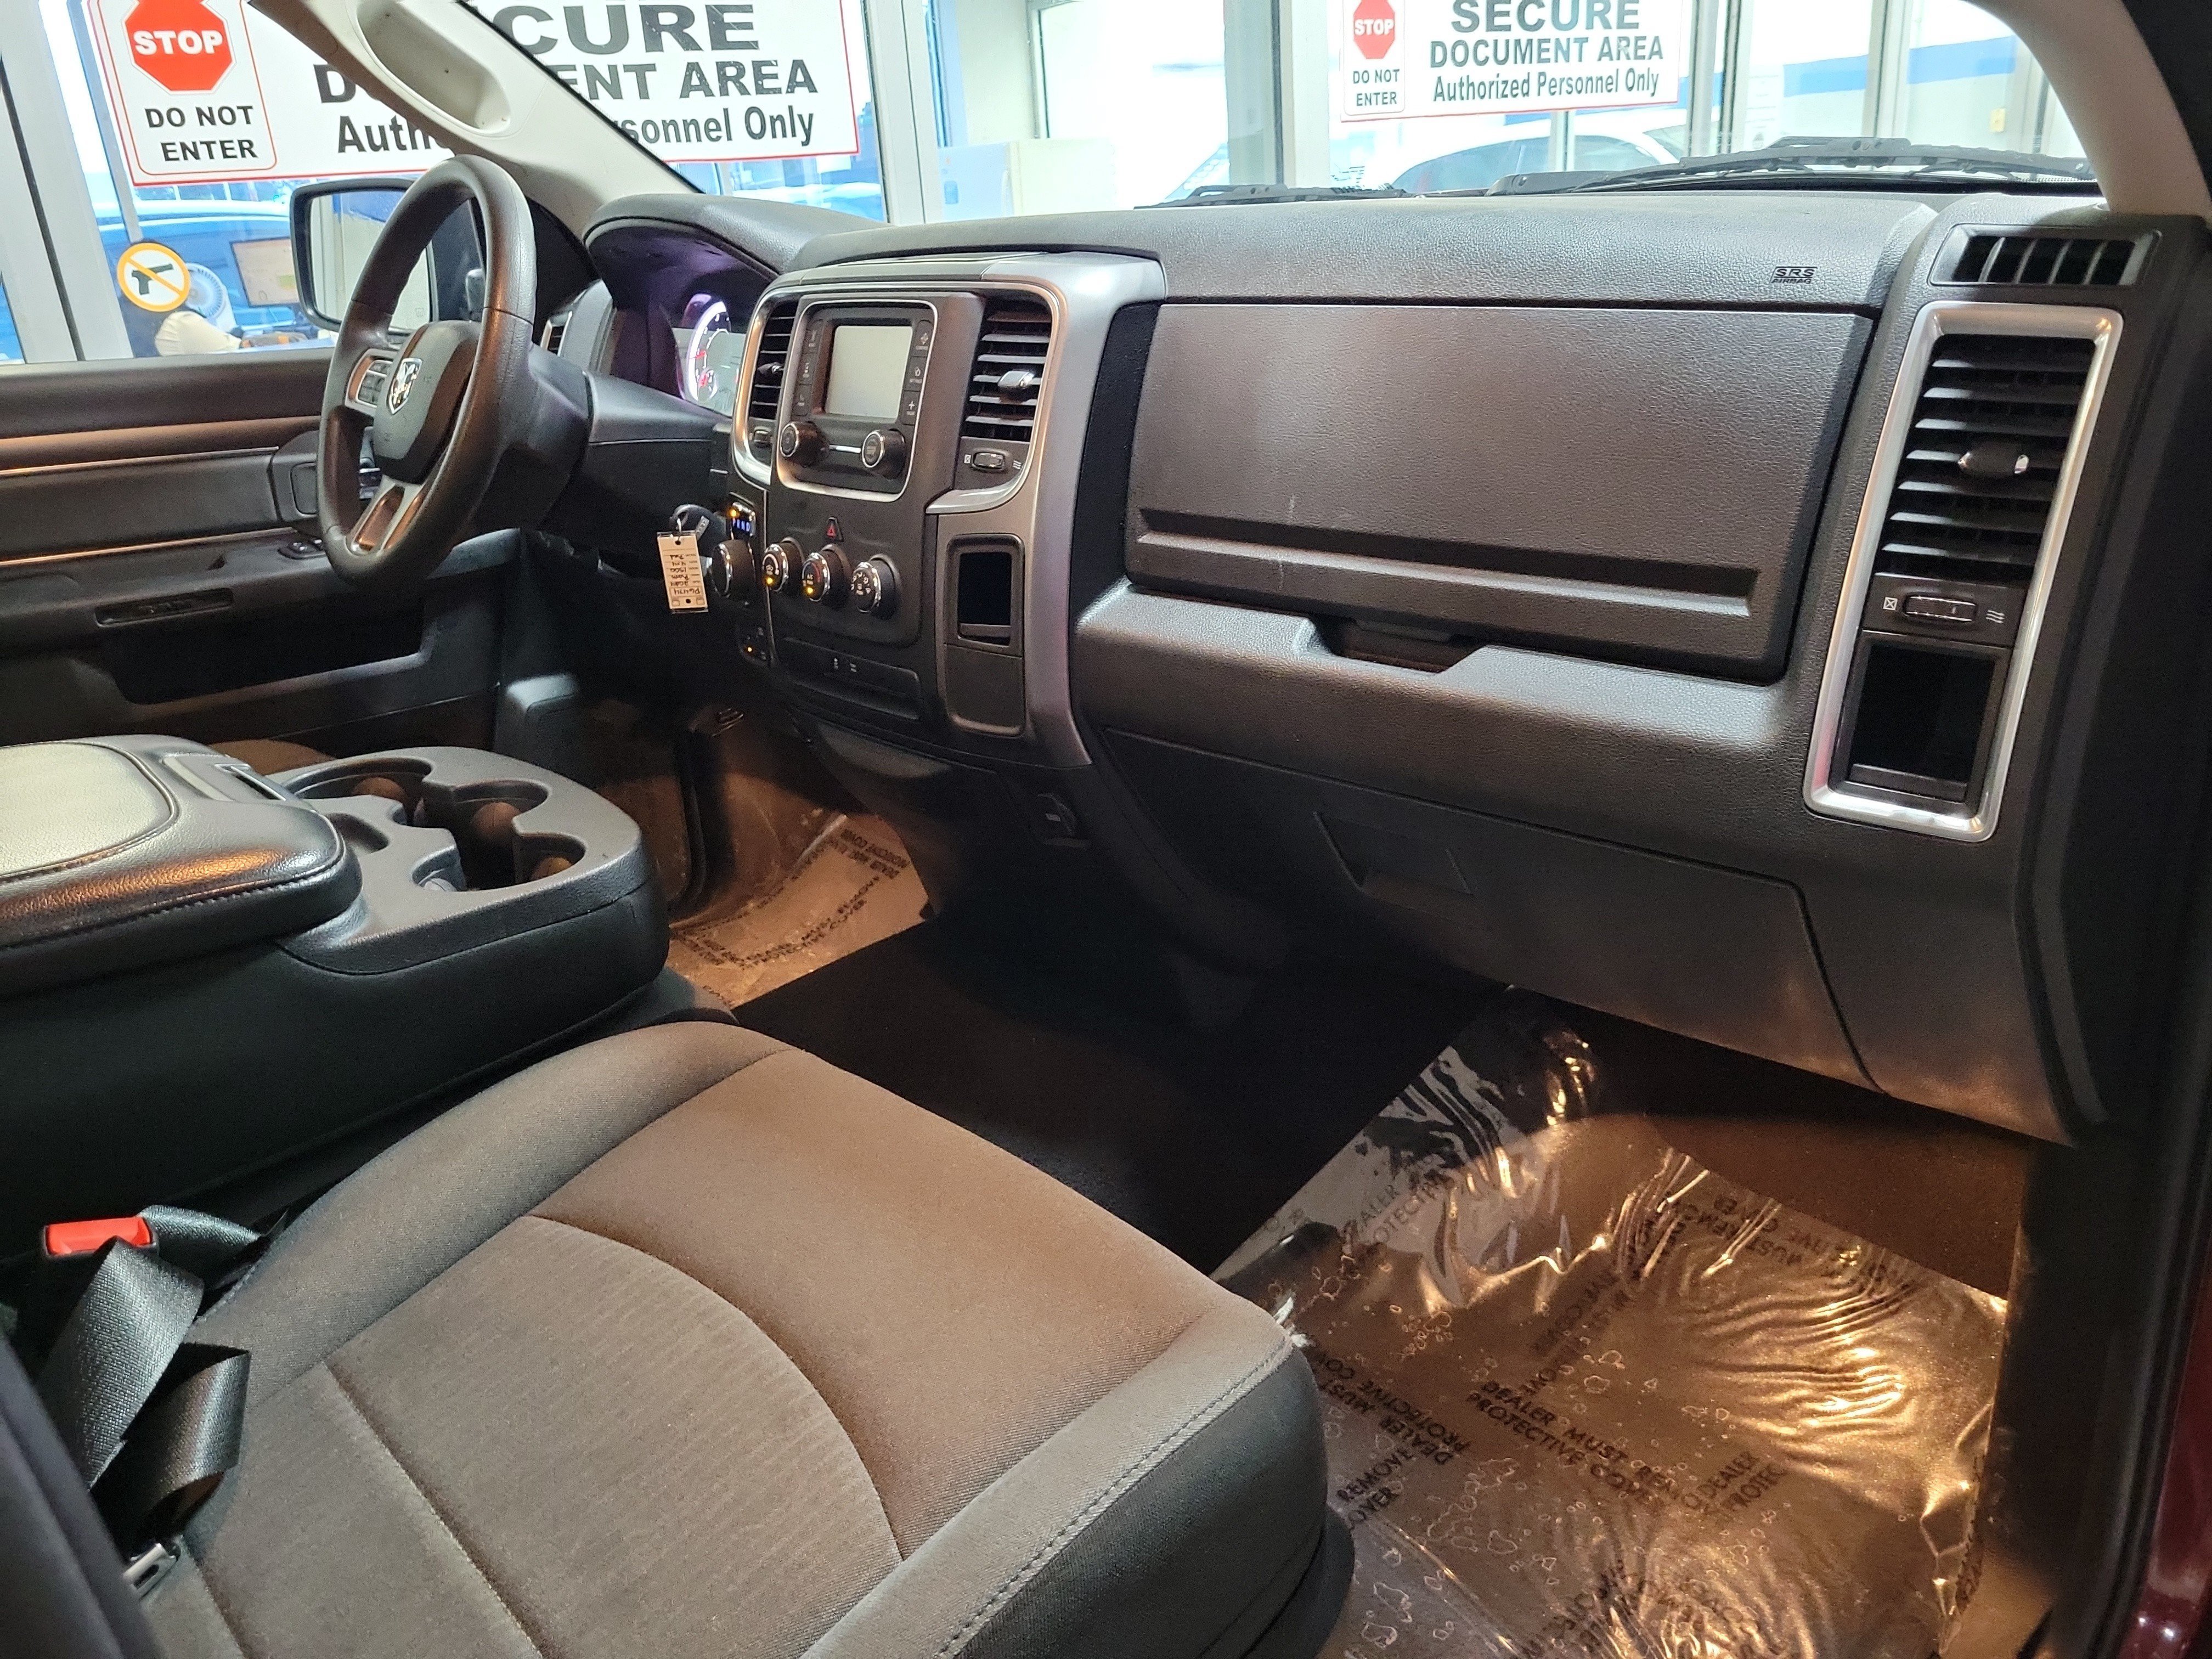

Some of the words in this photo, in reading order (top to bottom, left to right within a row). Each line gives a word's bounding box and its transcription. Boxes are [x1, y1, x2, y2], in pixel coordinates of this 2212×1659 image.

[1355, 19, 1394, 36] STOP
[1452, 0, 1640, 33] SECURE
[133, 30, 223, 55] STOP
[1430, 37, 1589, 68] DOCUMENT
[1597, 36, 1663, 62] AREA
[679, 59, 819, 99] AREA
[1353, 70, 1369, 84] DO
[1375, 69, 1400, 83] NOT
[1433, 72, 1530, 102] Authorized
[1537, 68, 1618, 97] Personnel
[1625, 67, 1659, 97] Only
[1356, 92, 1397, 106] ENTER
[145, 108, 186, 128] DO
[195, 105, 253, 126] NOT
[744, 105, 814, 146] Only
[160, 139, 259, 162] ENTER
[1775, 268, 1815, 277] SRS
